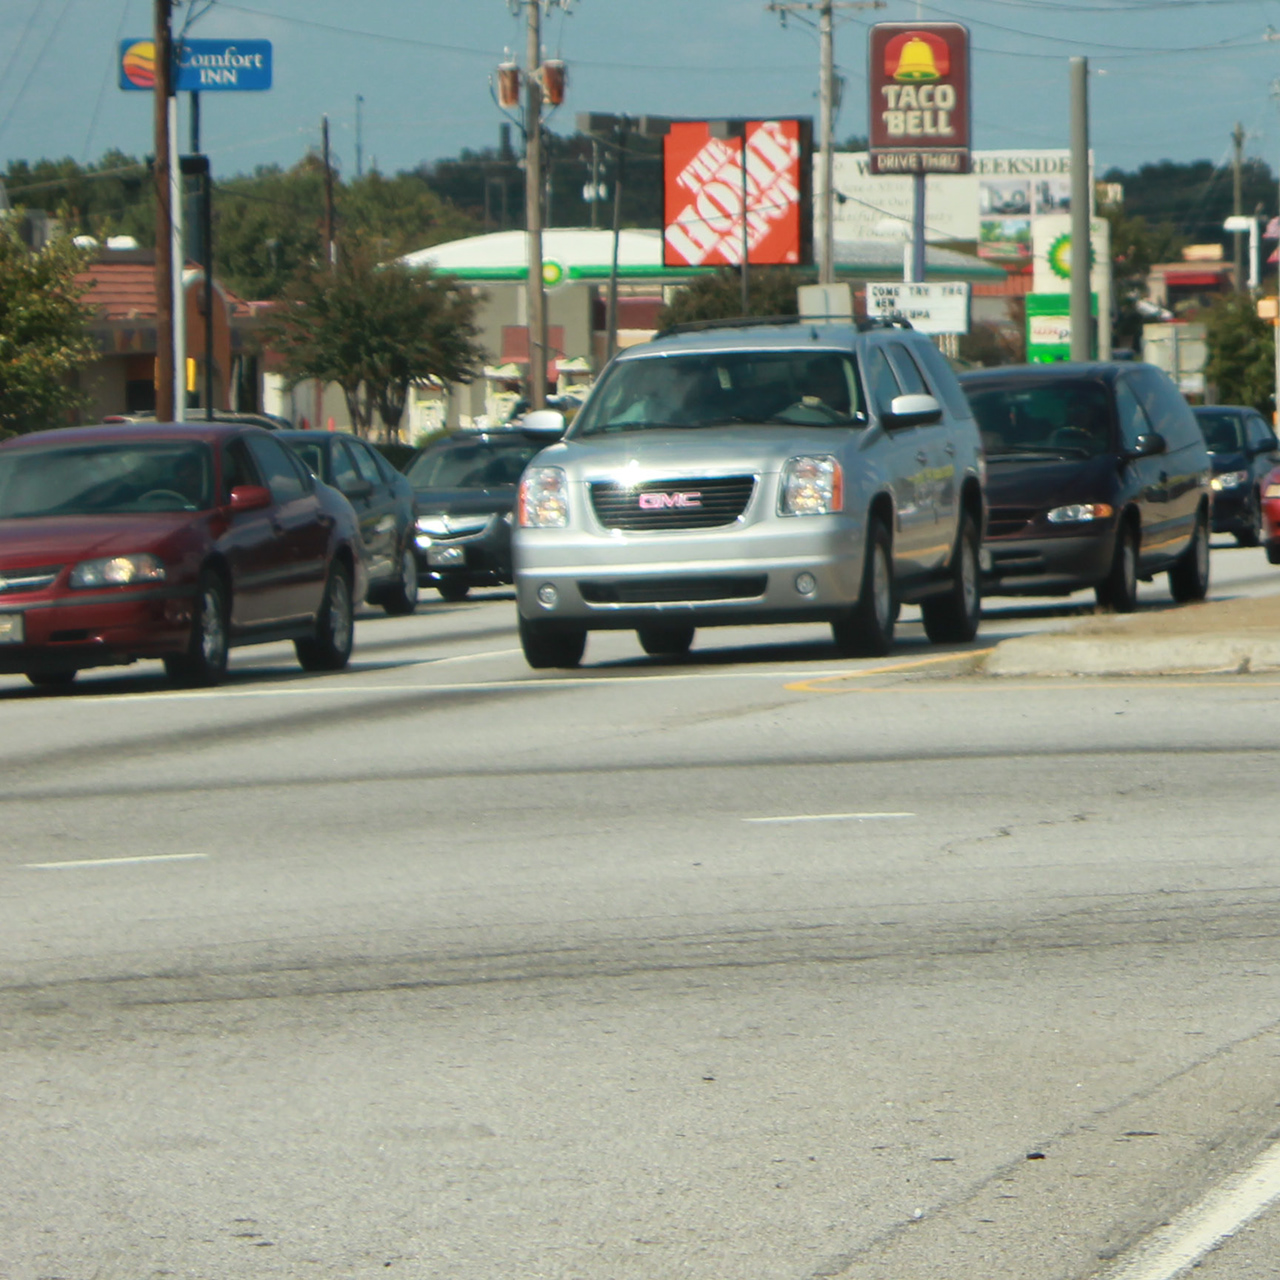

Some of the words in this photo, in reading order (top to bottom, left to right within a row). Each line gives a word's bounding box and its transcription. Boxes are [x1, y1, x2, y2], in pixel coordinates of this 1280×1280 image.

[176, 46, 263, 68] Comfort
[200, 69, 238, 84] INN
[881, 84, 956, 110] TACO
[881, 110, 955, 136] BELL
[675, 136, 735, 195] THE
[877, 153, 919, 170] DRIVE
[920, 152, 961, 170] THRU
[970, 157, 1071, 175] REEKSIDE
[665, 121, 800, 266] HOME
[715, 169, 800, 267] DEPOT
[872, 286, 900, 297] COME
[909, 286, 930, 296] TRY
[638, 491, 702, 509] GMC
